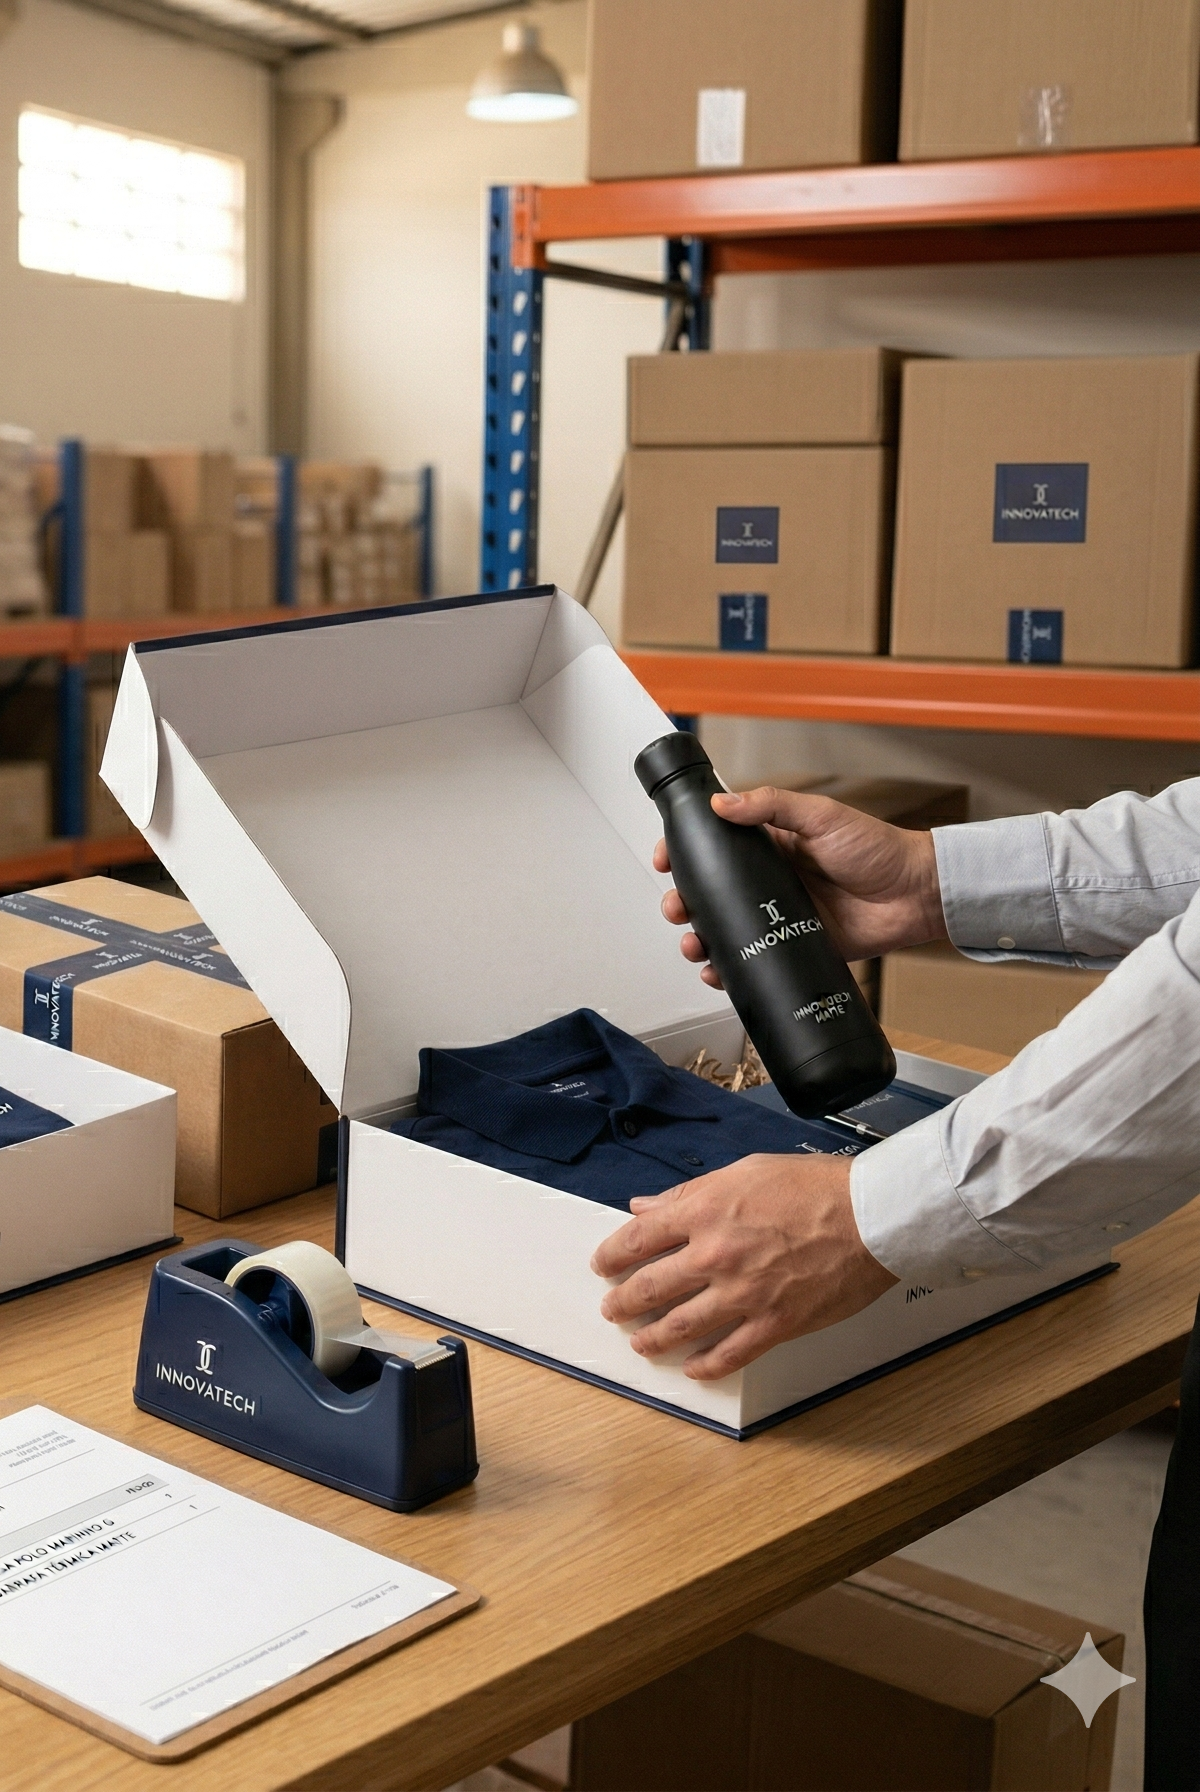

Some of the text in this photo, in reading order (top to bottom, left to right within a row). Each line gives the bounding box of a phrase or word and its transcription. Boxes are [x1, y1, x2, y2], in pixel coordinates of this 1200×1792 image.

[1002, 508, 1079, 520] INNOVATECH
[740, 916, 824, 960] INNOVATECH
[155, 1362, 256, 1416] INNOVATECH
